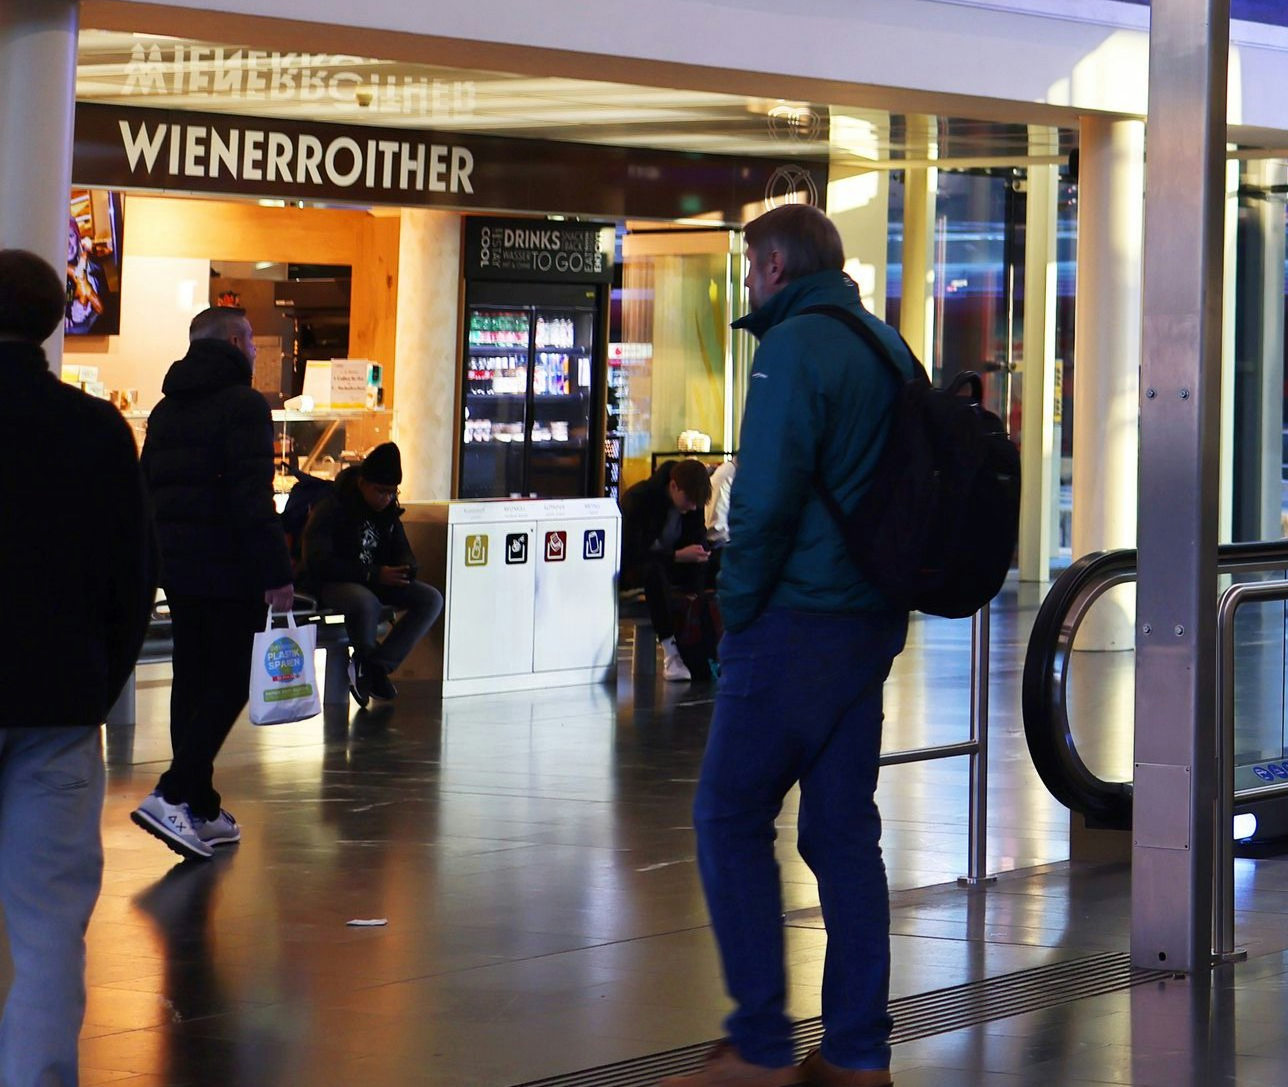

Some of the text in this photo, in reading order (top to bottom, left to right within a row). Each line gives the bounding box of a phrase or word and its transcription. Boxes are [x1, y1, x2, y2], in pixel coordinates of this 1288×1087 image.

[119, 120, 474, 194] WIENERROITHER
[504, 228, 561, 250] DRINKS
[532, 251, 552, 271] TO
[556, 251, 583, 272] GO
